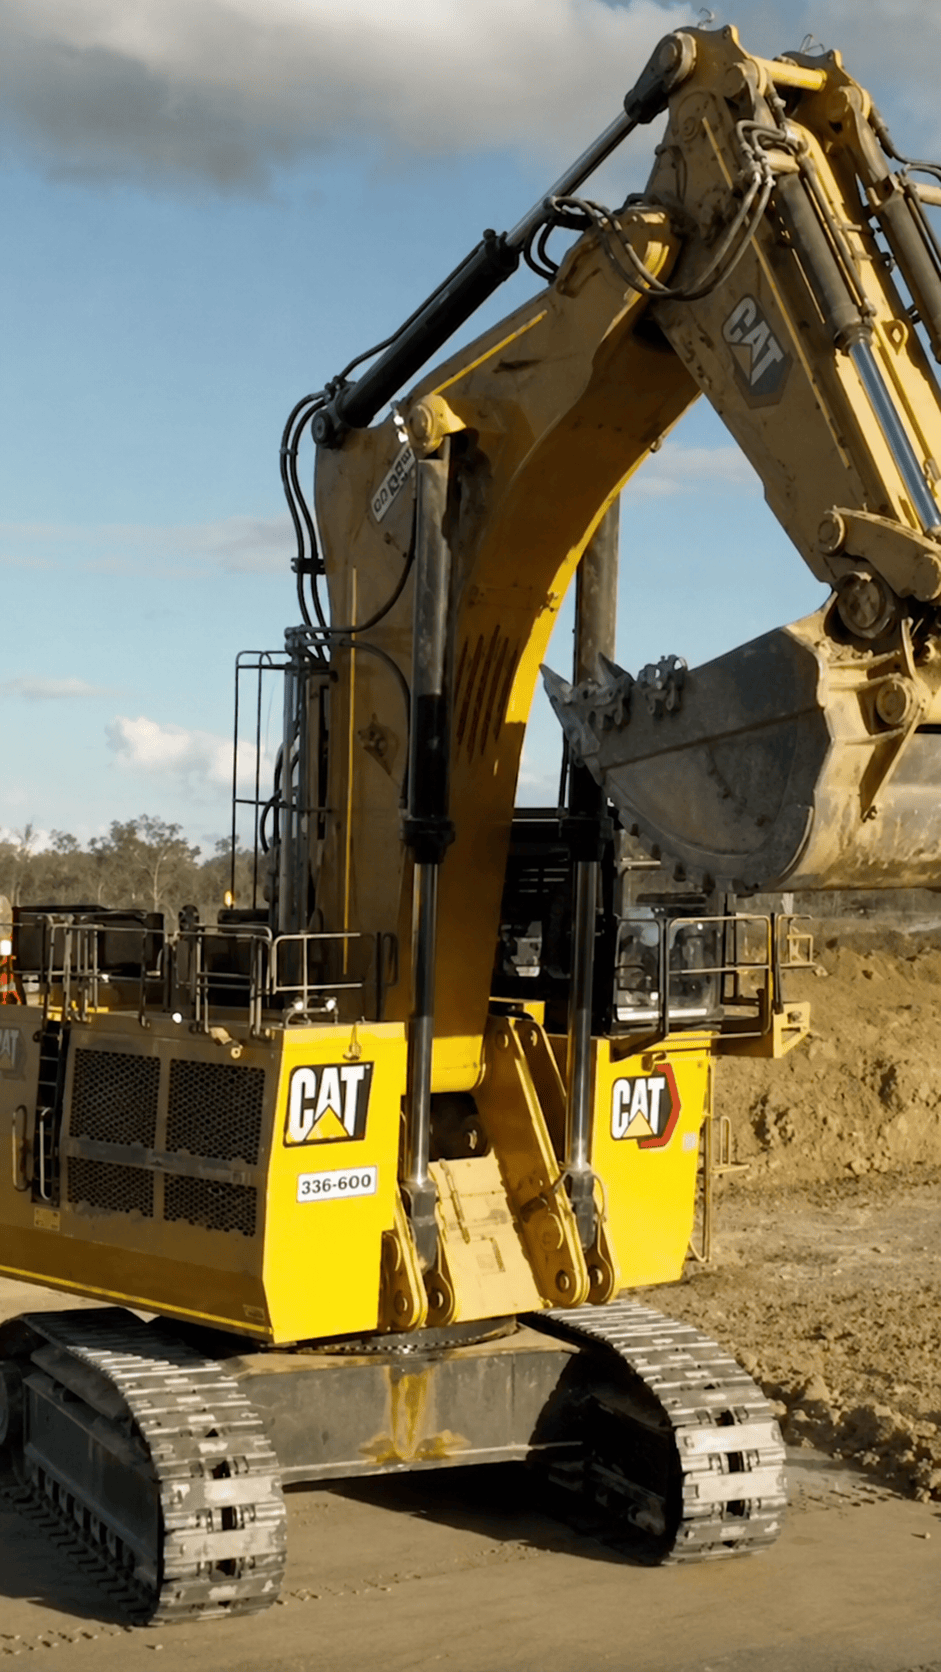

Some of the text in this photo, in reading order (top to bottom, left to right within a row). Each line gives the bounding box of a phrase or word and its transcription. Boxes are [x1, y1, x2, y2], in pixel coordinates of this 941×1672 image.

[722, 297, 785, 387] CAT
[0, 1029, 19, 1067] AT
[286, 1065, 365, 1142] CAT
[611, 1077, 666, 1139] CAT
[301, 1174, 372, 1195] 336-600
